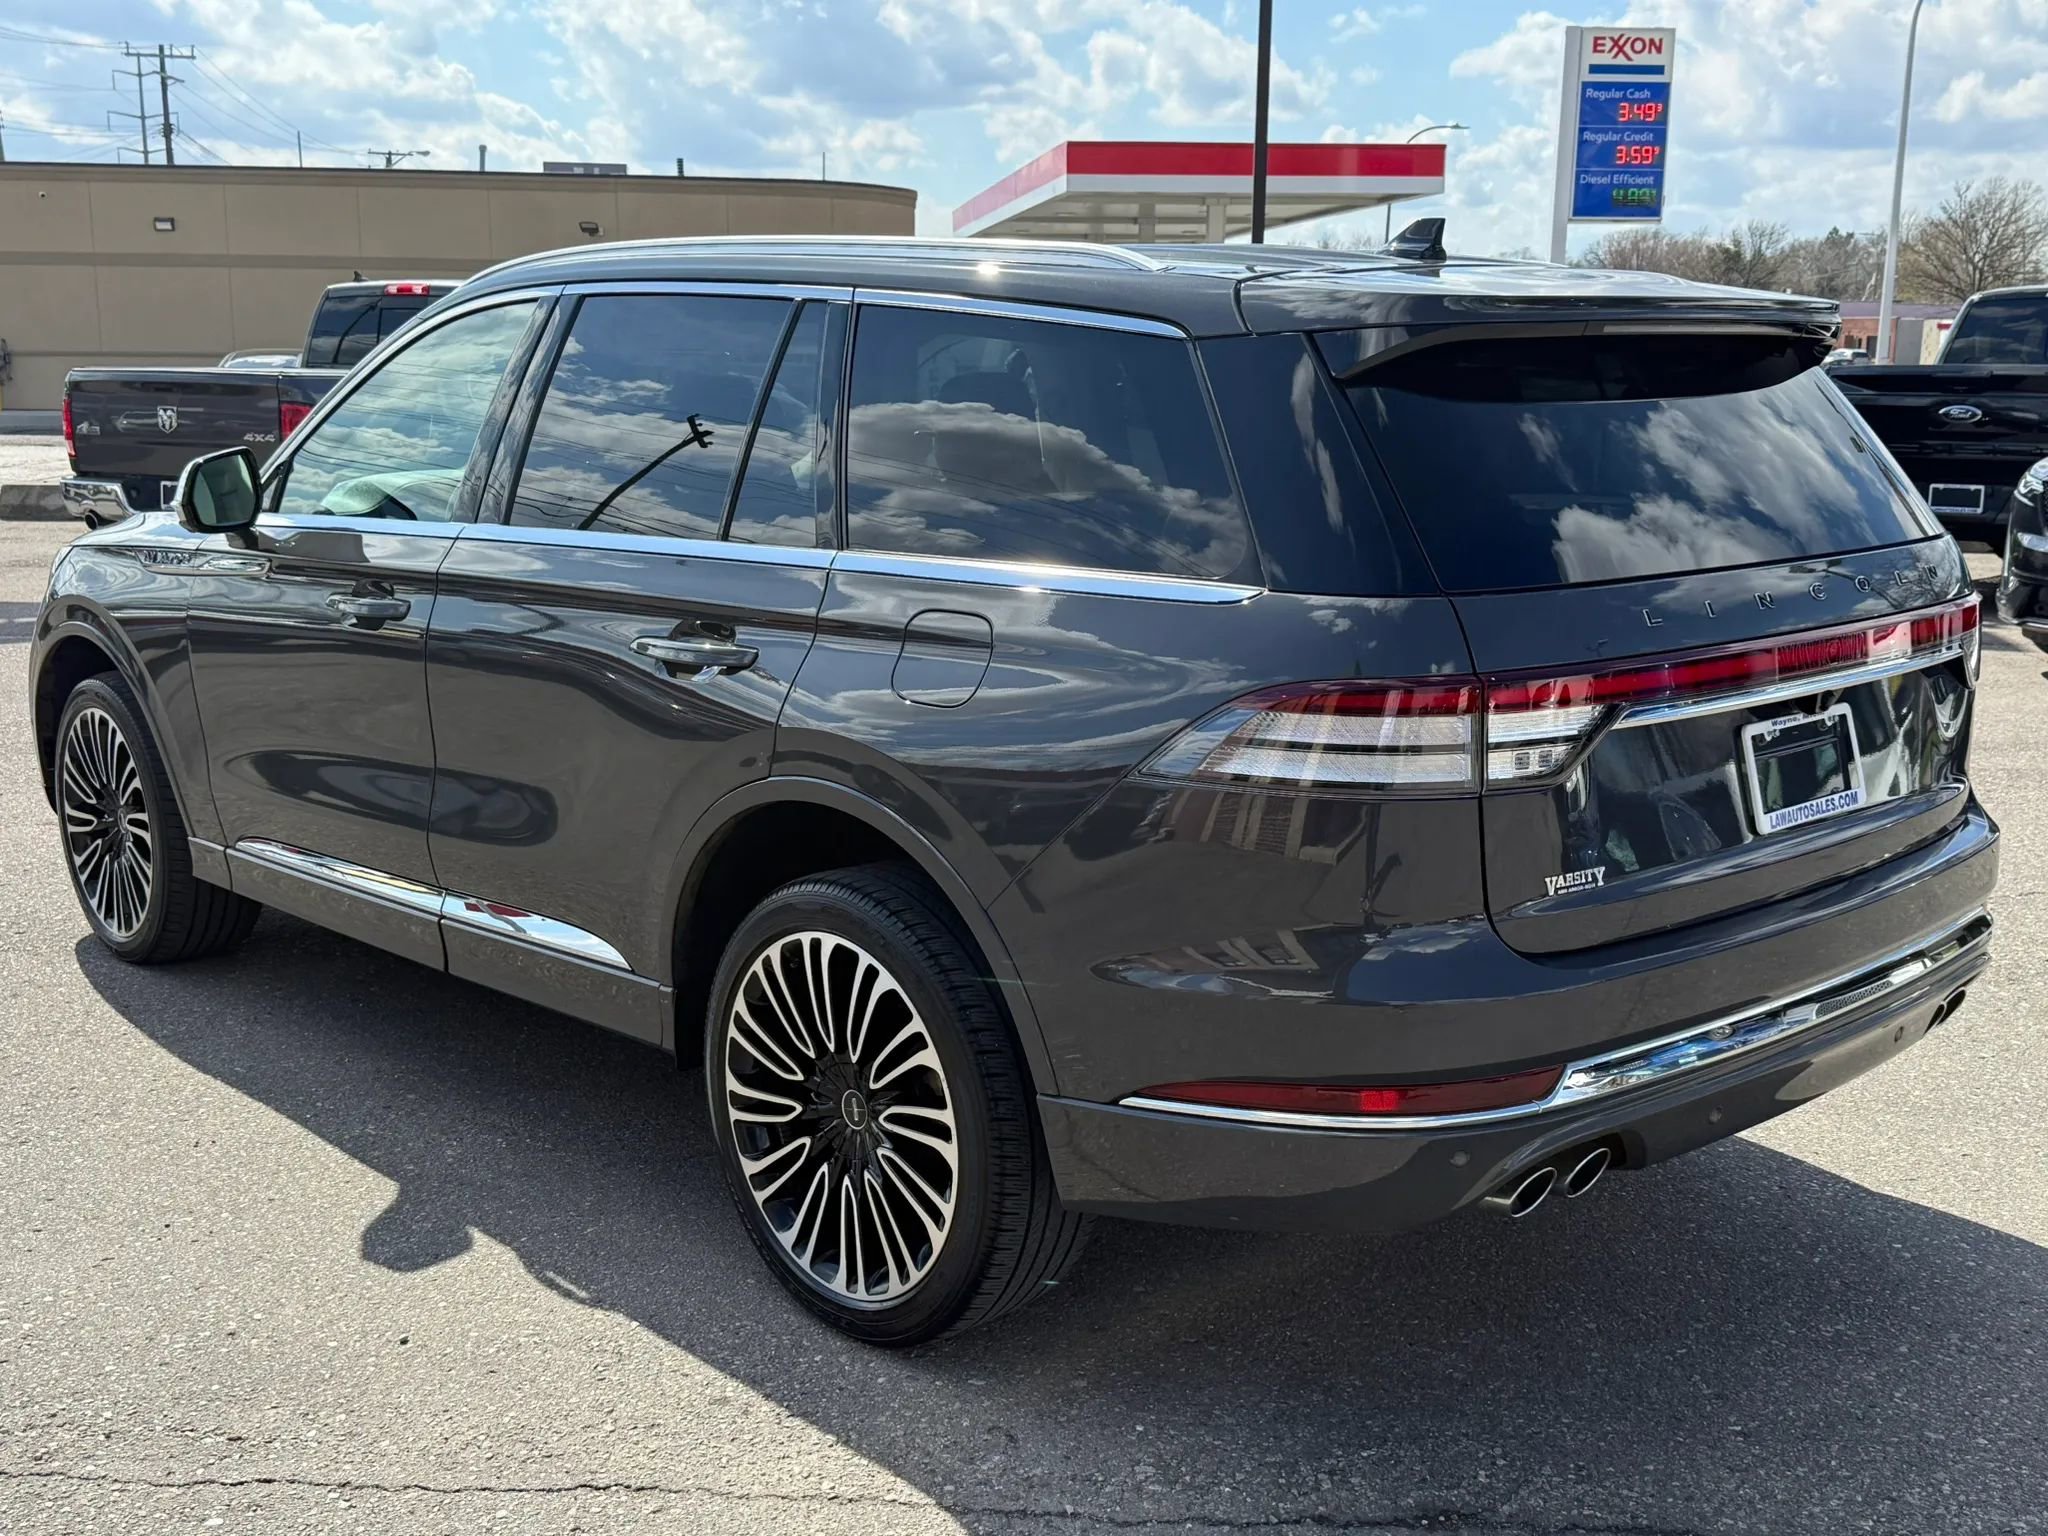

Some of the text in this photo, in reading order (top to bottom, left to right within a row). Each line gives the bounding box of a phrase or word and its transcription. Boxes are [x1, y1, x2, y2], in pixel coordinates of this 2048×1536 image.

[1592, 33, 1663, 62] EXXON
[1585, 88, 1651, 100] Regular Cash
[1583, 131, 1654, 144] Regular Credit
[1580, 174, 1655, 185] Diesel Efficient
[1642, 564, 1938, 627] LINCOLN
[1770, 791, 1858, 829] LAWAUTOSALES.COM
[1544, 866, 1606, 896] VARSITY
